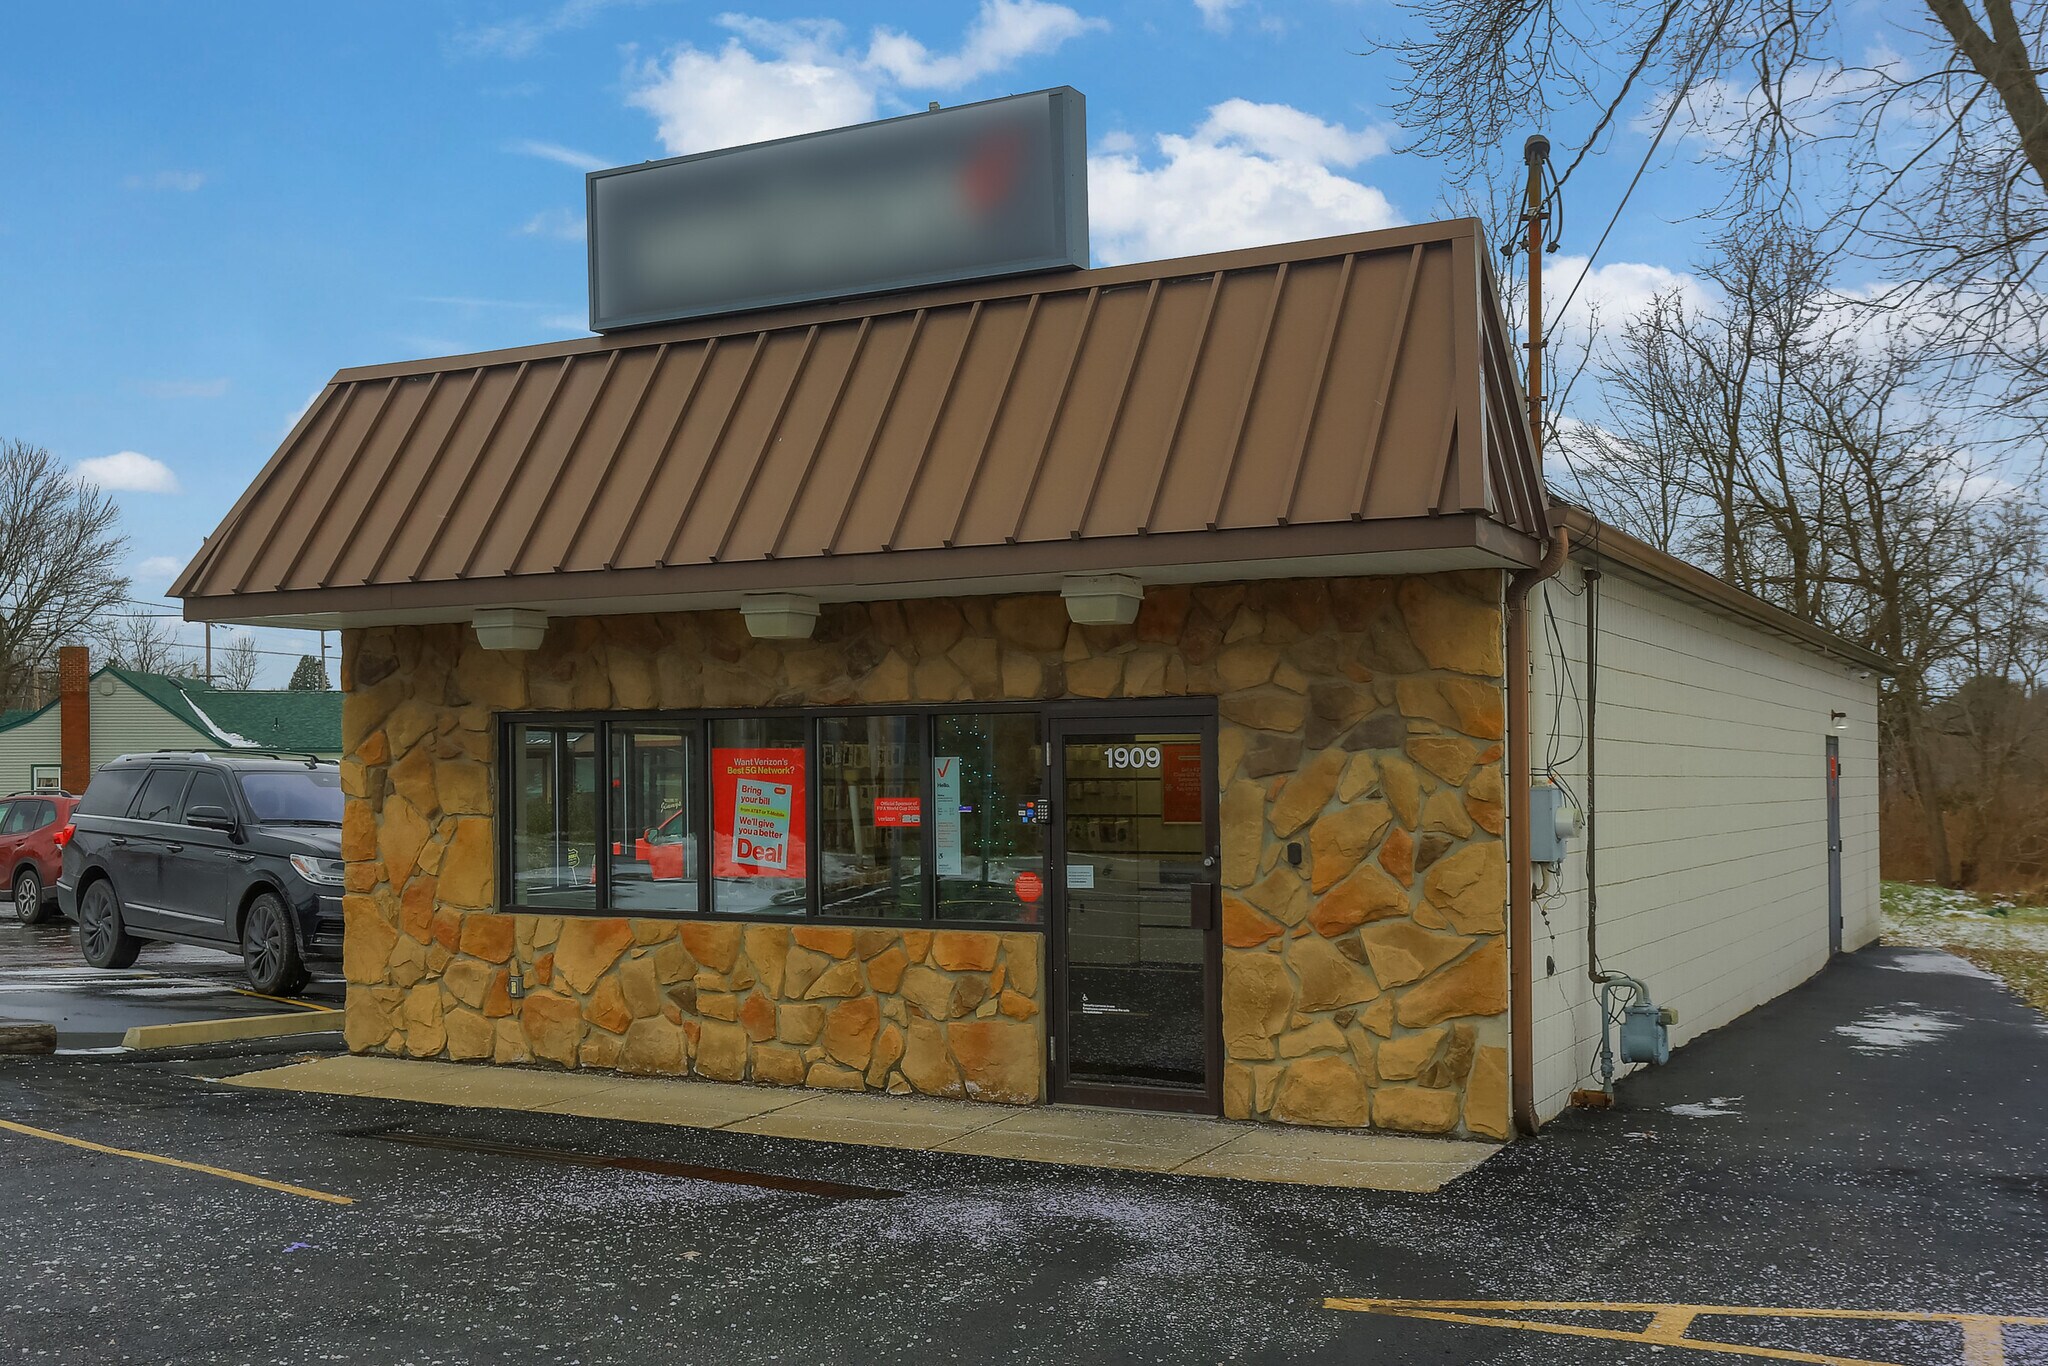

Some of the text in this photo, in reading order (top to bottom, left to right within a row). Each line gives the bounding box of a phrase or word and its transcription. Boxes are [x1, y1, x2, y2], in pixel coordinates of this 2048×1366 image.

[754, 757, 788, 766] Verizon's
[1104, 747, 1161, 769] 1909
[727, 766, 795, 775] Best 5G Network?
[741, 785, 762, 796] Bring
[740, 795, 771, 806] your bill
[740, 816, 775, 829] We'll give
[759, 829, 783, 839] better
[737, 837, 783, 864] Deal
